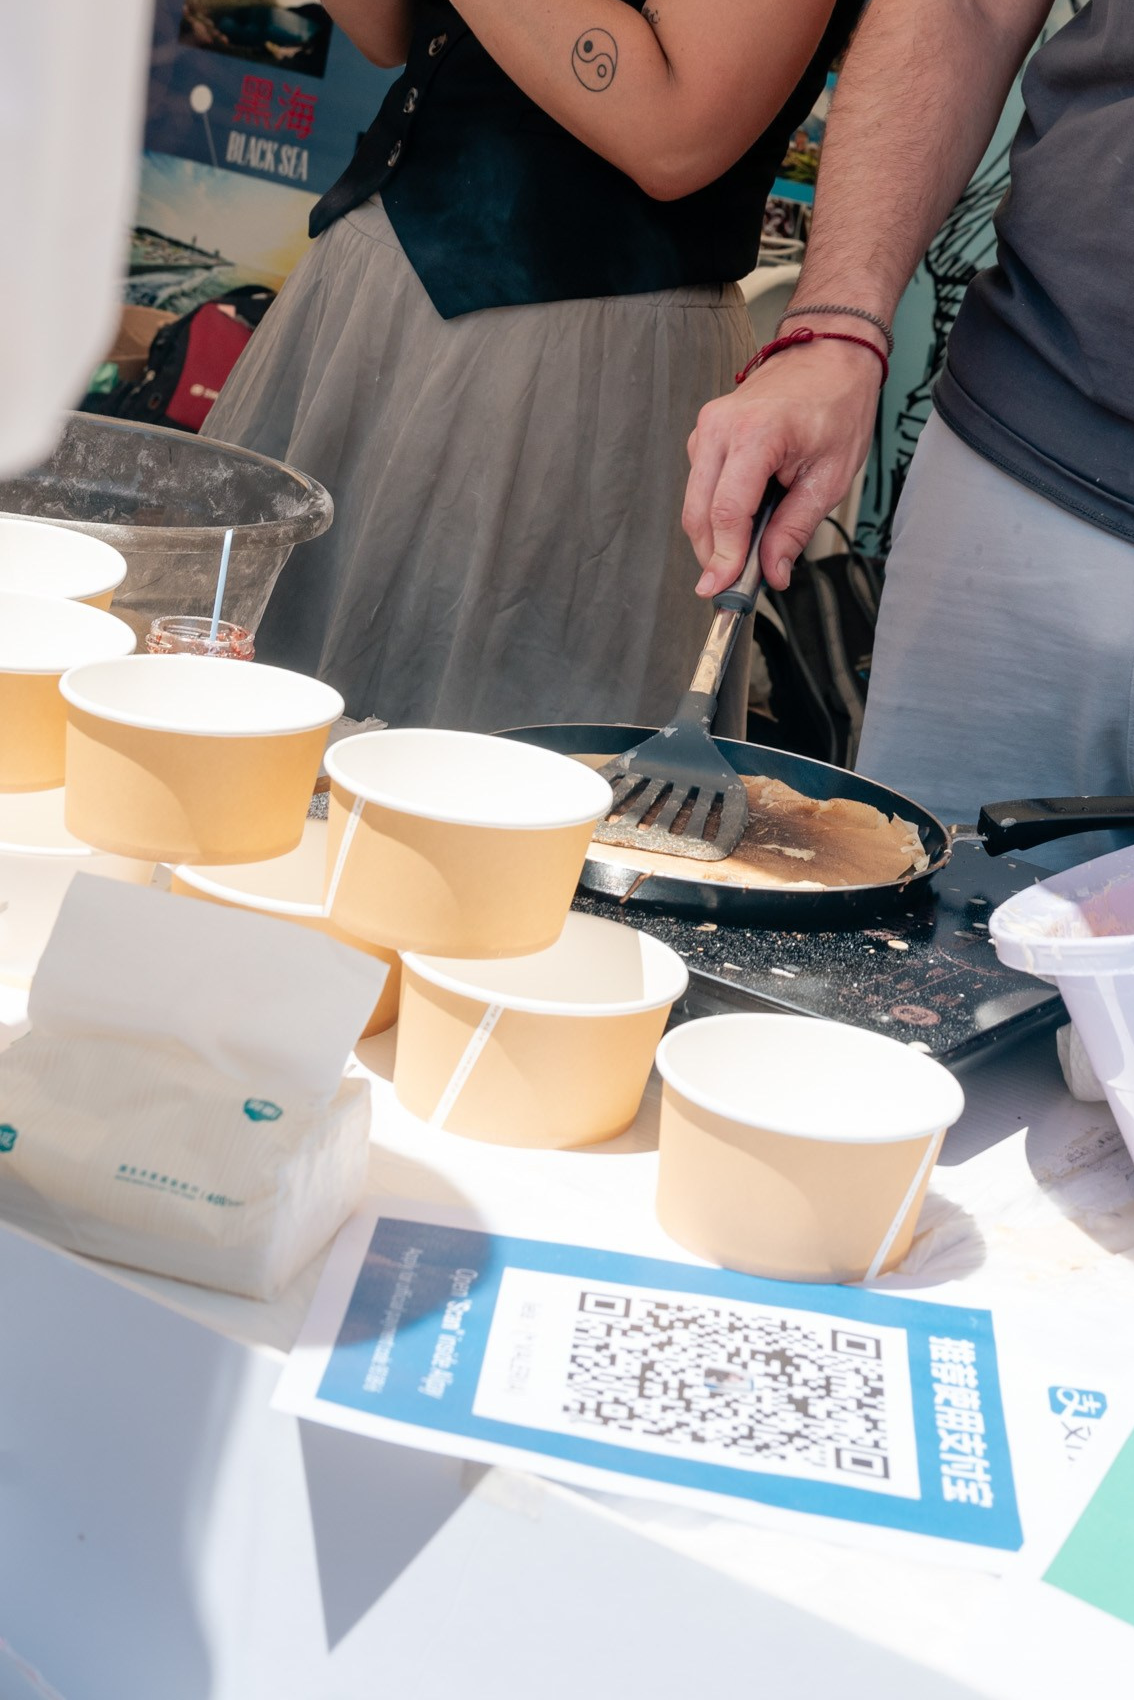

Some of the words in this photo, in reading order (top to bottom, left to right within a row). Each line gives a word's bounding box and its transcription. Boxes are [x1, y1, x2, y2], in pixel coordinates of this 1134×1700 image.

[232, 75, 319, 140] 黑海
[225, 130, 279, 173] BLACK
[278, 144, 309, 182] SEA
[928, 1335, 994, 1508] 推荐使用支付宝
